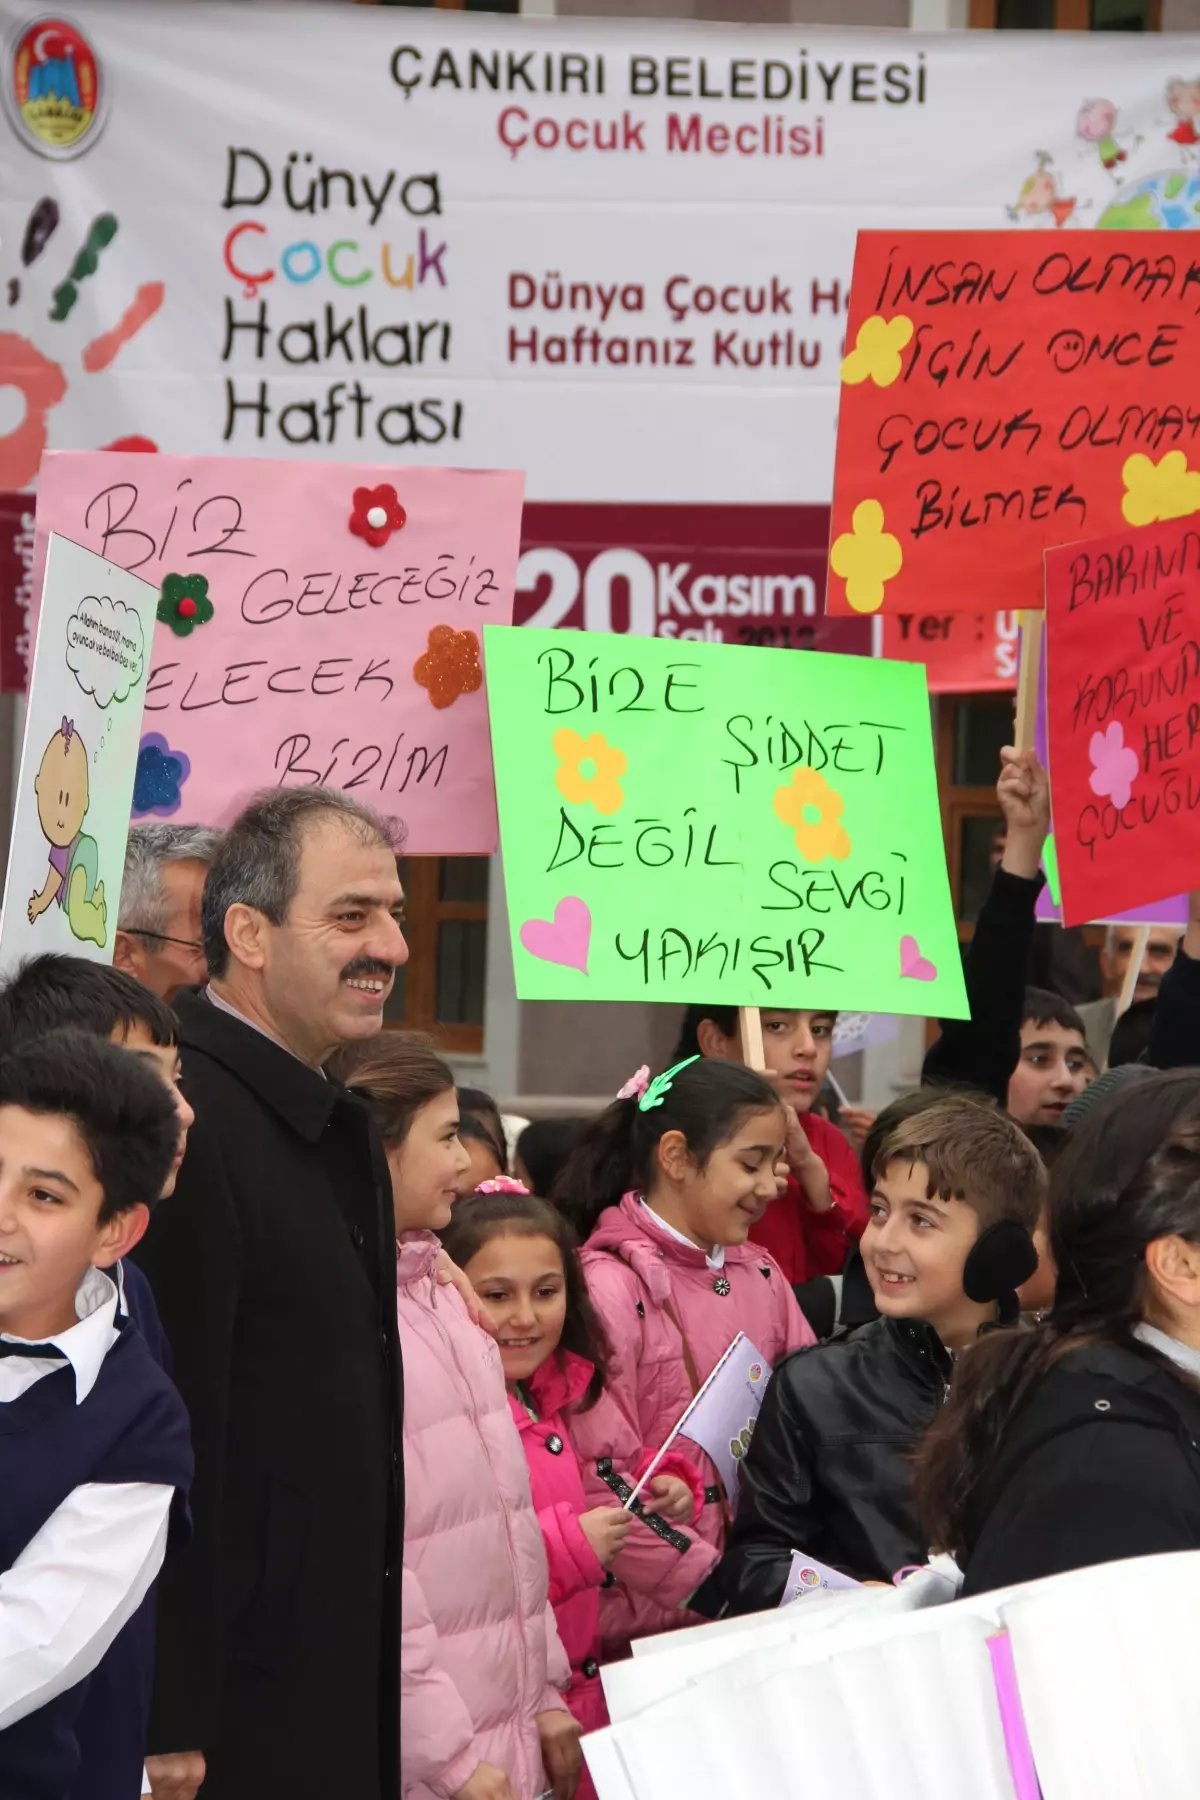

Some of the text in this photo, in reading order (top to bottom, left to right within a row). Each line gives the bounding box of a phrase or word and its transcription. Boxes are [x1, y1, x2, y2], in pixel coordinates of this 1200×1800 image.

[390, 45, 926, 105] ÇANKIRI BELEDİYESİ
[498, 106, 825, 159] Çocuk Meclisi
[222, 146, 443, 226] Dünya
[223, 220, 448, 298] Çocuk
[875, 246, 1017, 312] İNSAN
[508, 271, 850, 321] Dünya Çocuk H
[222, 296, 452, 365] Hakları
[508, 328, 695, 367] Haftanız
[714, 330, 821, 369] Kutlu
[904, 324, 1024, 388] İÇİN
[1047, 325, 1183, 374] ÖNCE
[223, 378, 464, 445] Haftası
[877, 408, 1042, 473] ÇOCUK
[85, 479, 257, 571] BİZ
[911, 479, 1087, 540] BİLMEK
[241, 555, 500, 625] GELECEĞİZ
[515, 547, 817, 638] 20 Kasım
[1138, 591, 1185, 652] VE
[122, 635, 137, 652] mama
[144, 658, 394, 711] ELECEK
[537, 648, 704, 713] BİZE
[721, 715, 907, 793] ŞİDDET
[546, 807, 742, 873] DEĞİL
[761, 852, 907, 915] SEVGİ
[615, 928, 845, 990] YAKIŞIR
